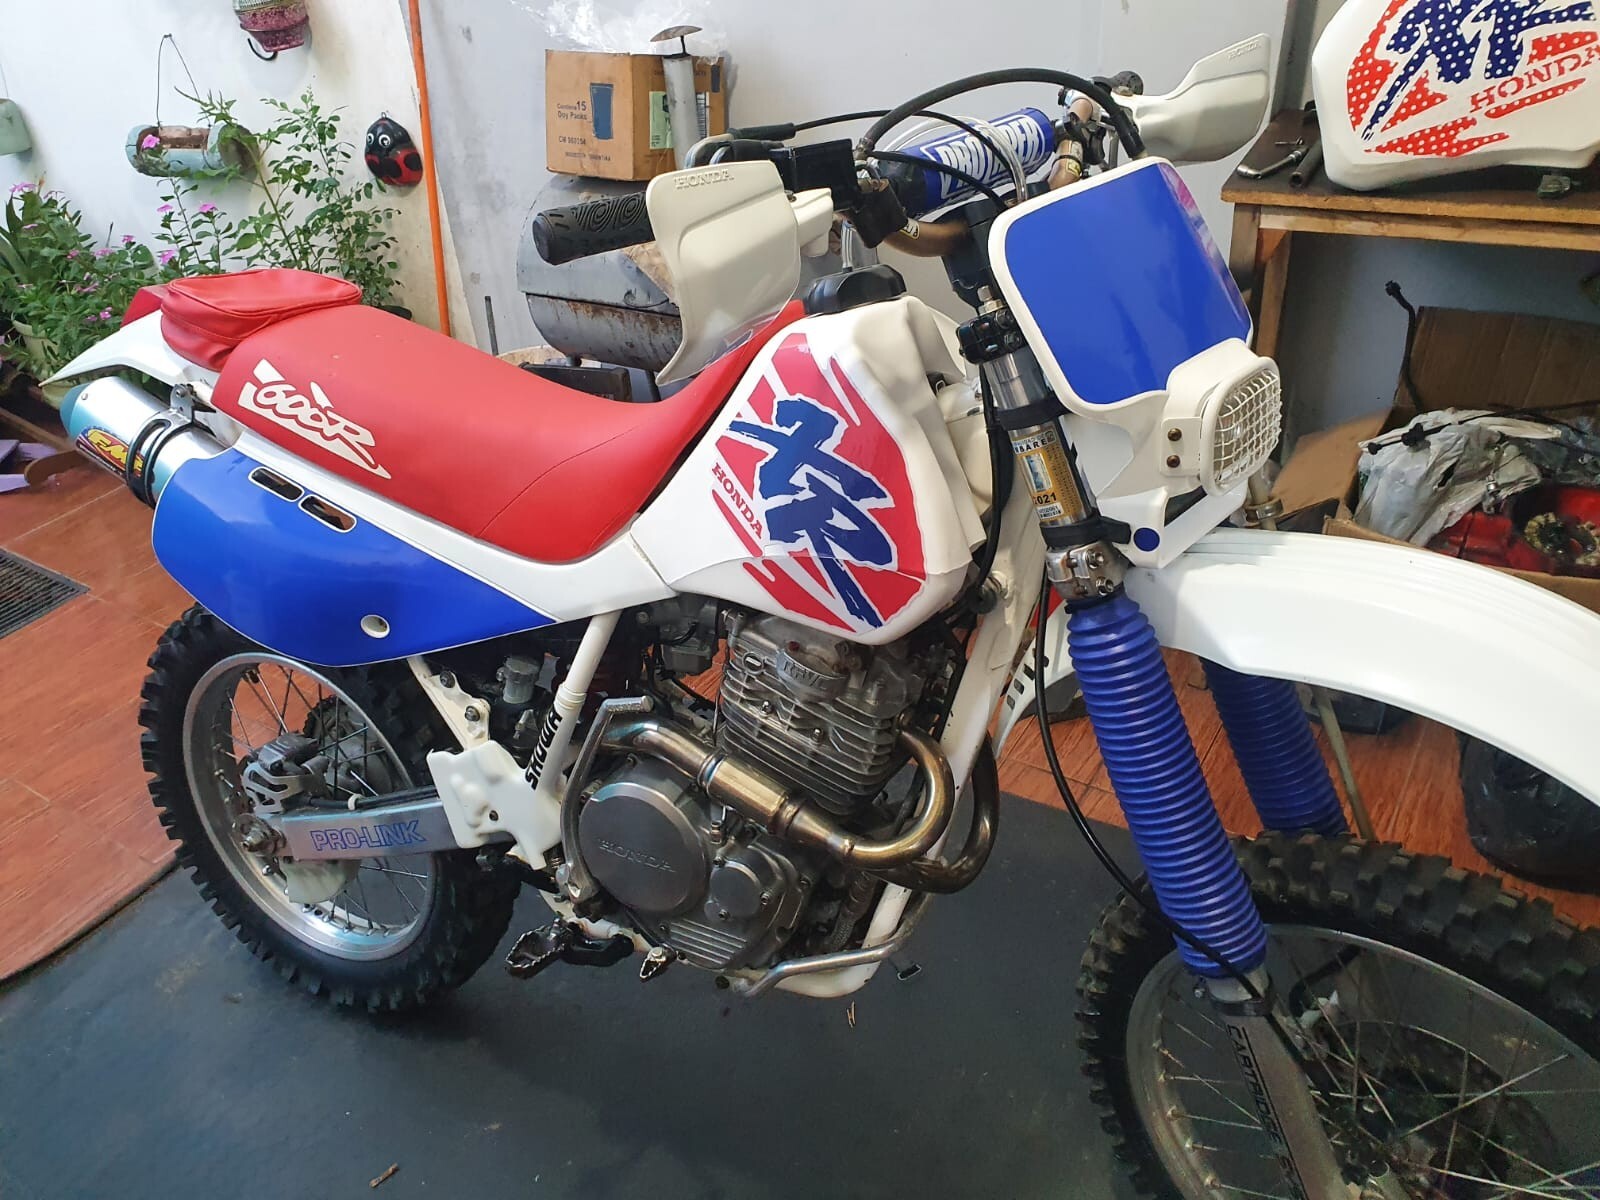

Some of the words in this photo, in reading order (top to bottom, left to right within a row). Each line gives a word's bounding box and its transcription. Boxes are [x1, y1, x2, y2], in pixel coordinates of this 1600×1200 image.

[577, 101, 587, 111] 15
[674, 168, 735, 190] HONDA
[711, 462, 764, 540] HONDA
[525, 704, 563, 791] SHOWA
[310, 819, 427, 852] PRO-LINK
[598, 838, 677, 873] HONDA
